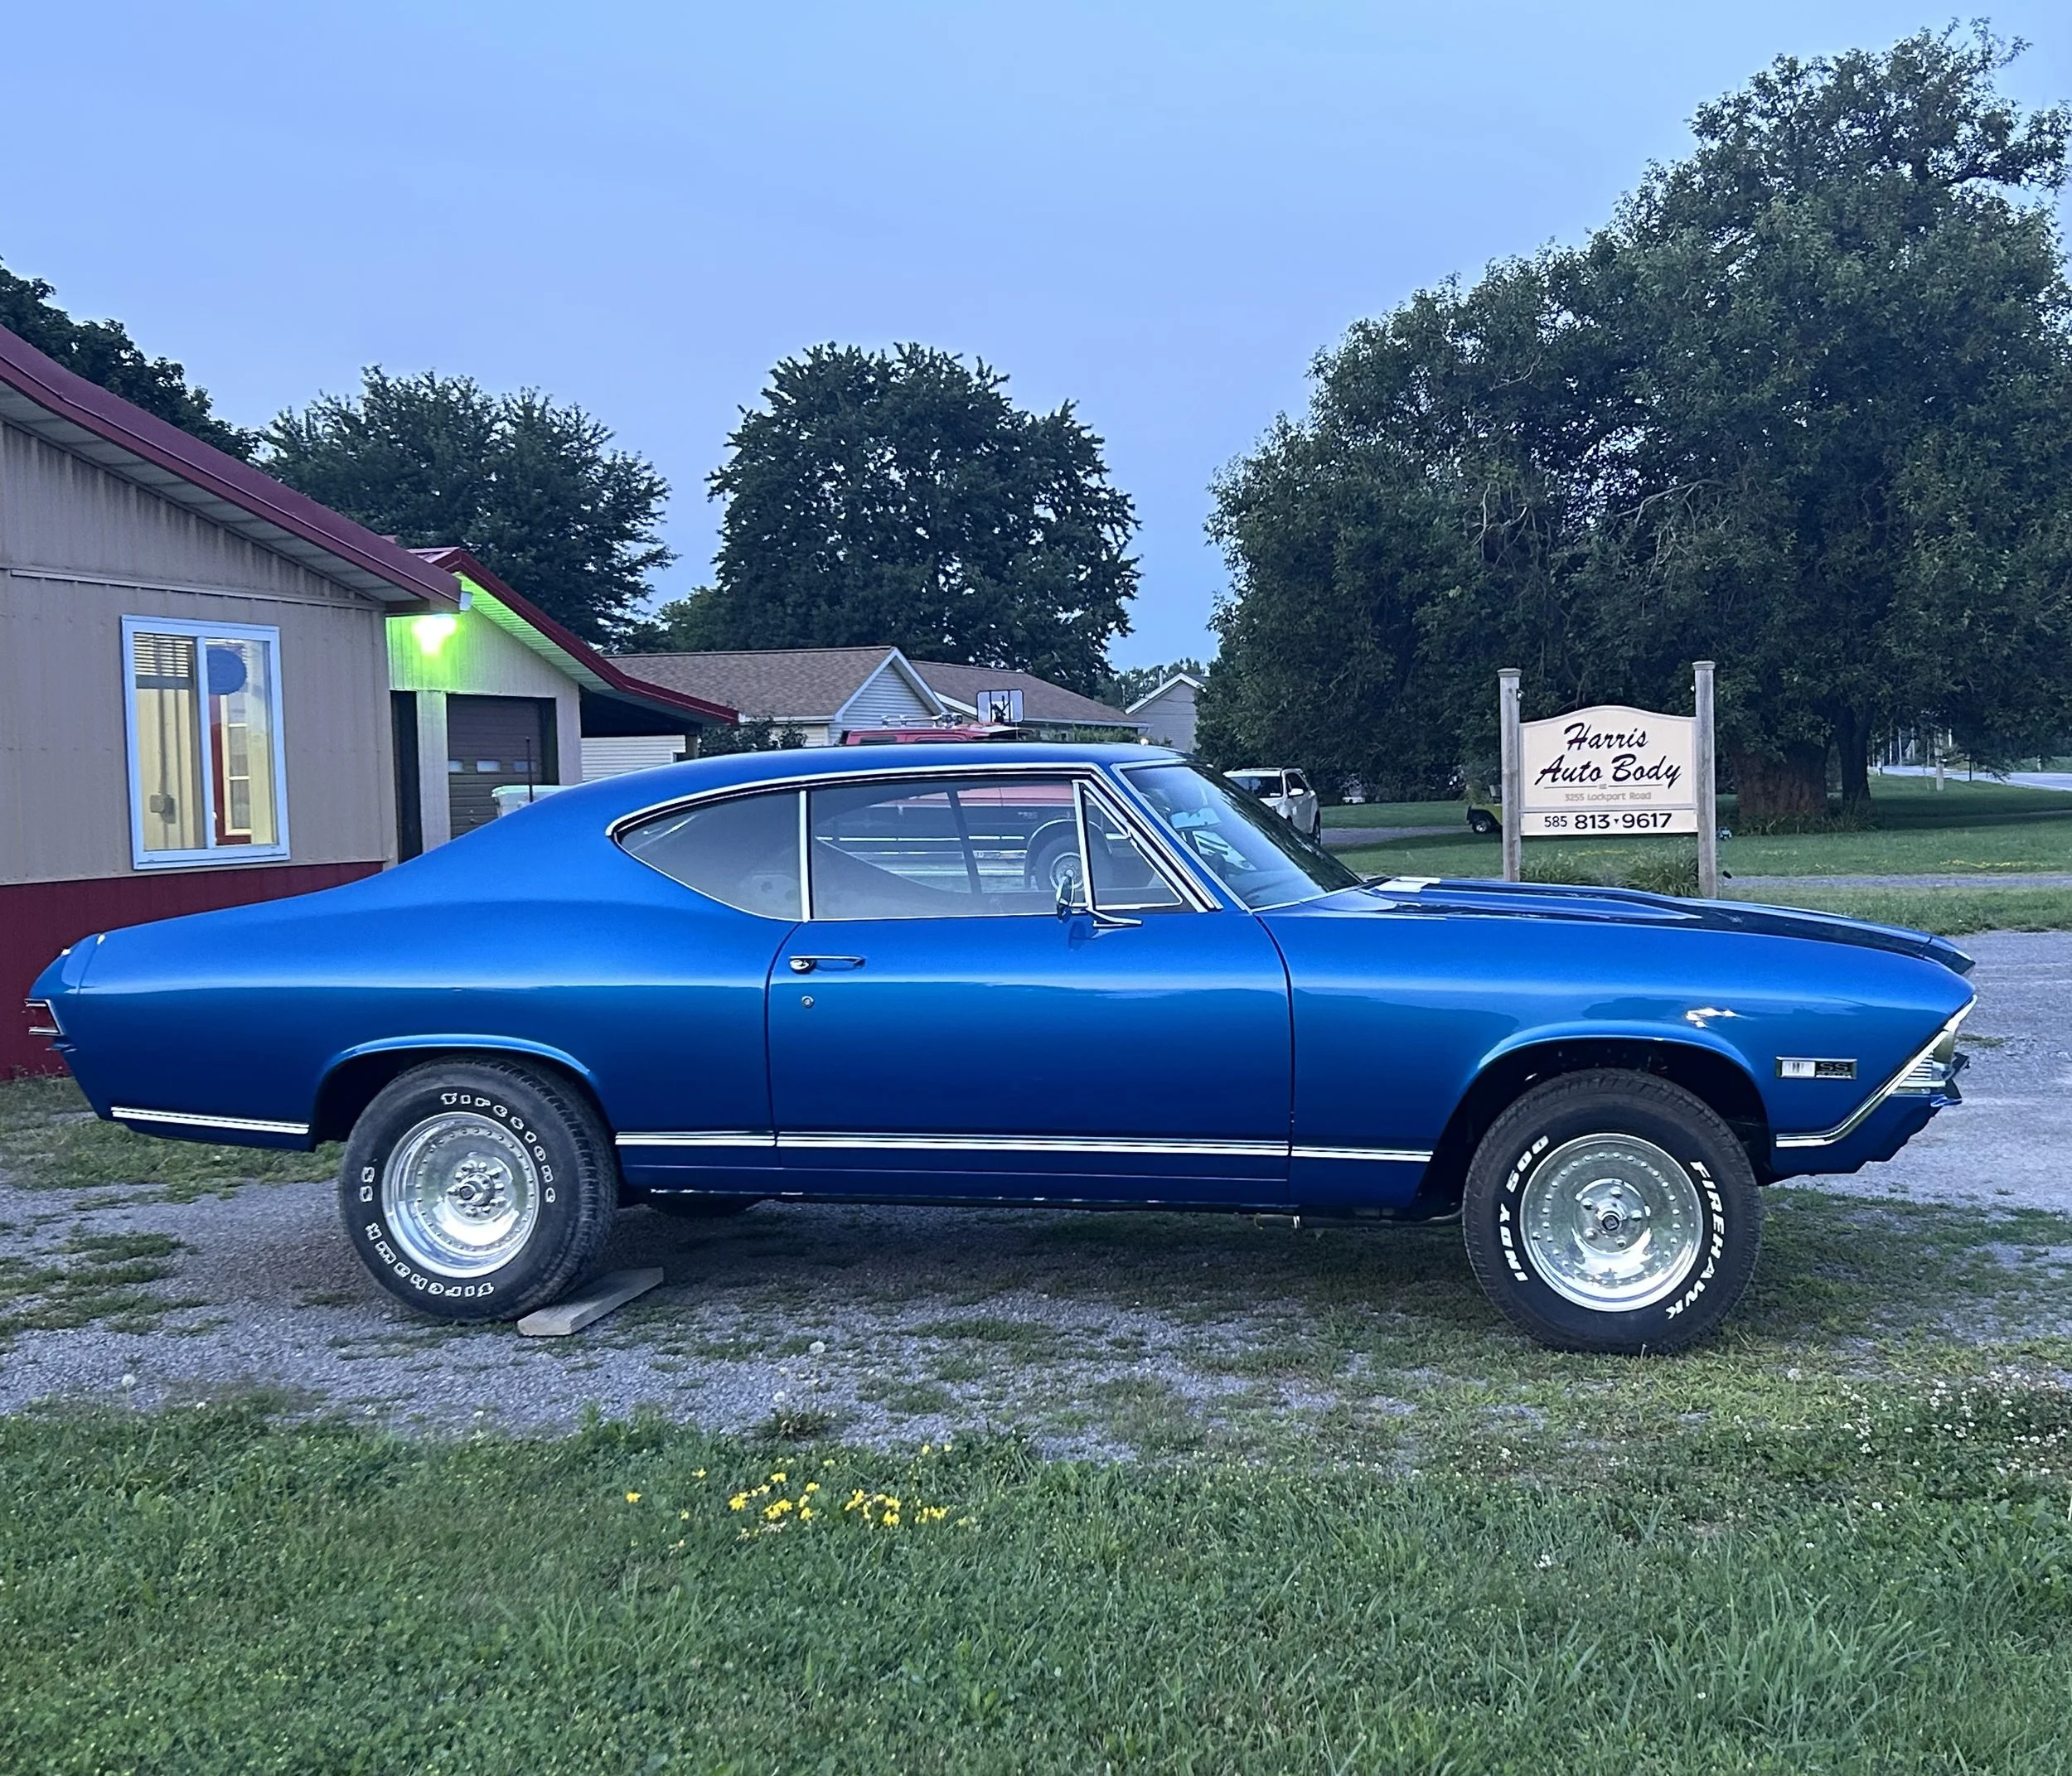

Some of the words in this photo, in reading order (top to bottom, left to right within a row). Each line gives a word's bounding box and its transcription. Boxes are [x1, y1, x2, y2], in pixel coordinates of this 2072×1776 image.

[1564, 722, 1648, 751] Harris
[1534, 754, 1602, 786] Auto
[1611, 753, 1682, 789] Body
[1564, 792, 1585, 801] 3255
[1587, 793, 1626, 801] Lockport
[1629, 791, 1652, 800] Road
[1544, 815, 1567, 828] 585
[1820, 1062, 1848, 1072] SS
[1506, 1135, 1549, 1193] 500
[1499, 1203, 1528, 1281] INDY
[1666, 1161, 1724, 1319] FIREHAWK
